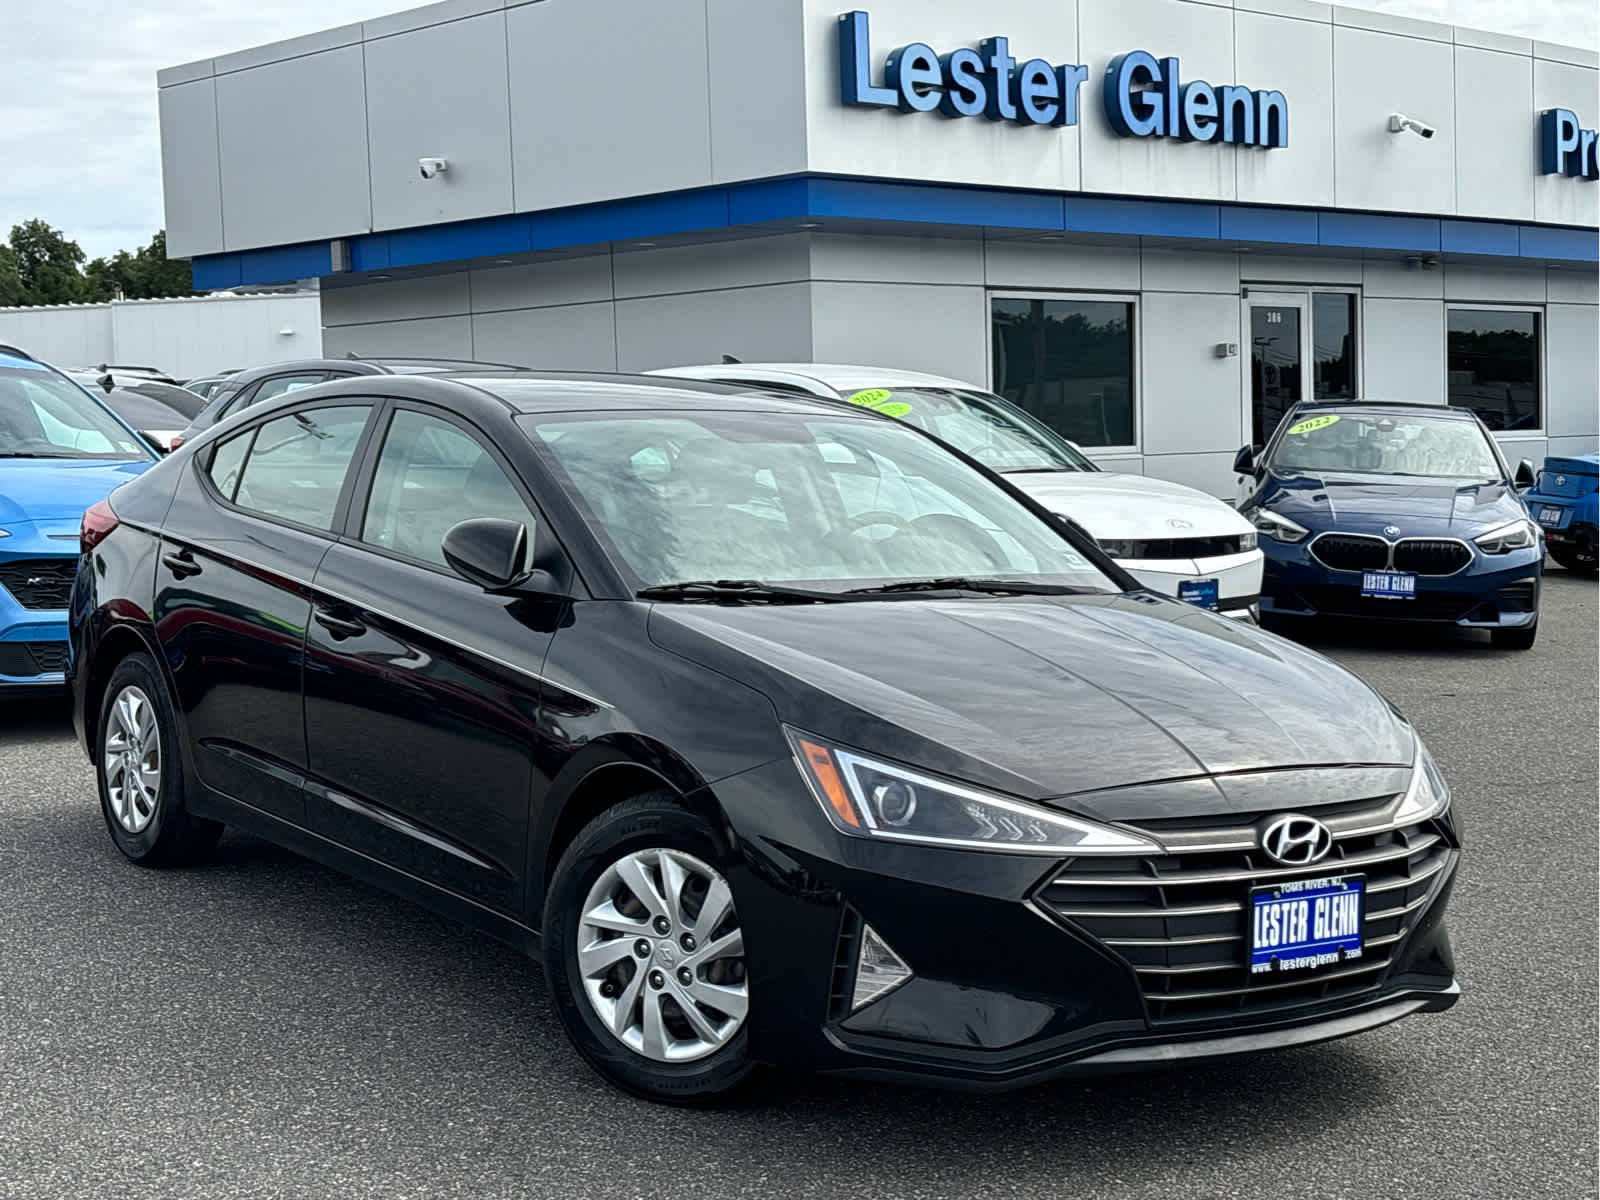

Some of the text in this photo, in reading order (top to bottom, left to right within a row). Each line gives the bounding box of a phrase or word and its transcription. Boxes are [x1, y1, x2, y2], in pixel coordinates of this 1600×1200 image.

[841, 10, 1289, 148] Lester Glenn
[1541, 108, 1599, 180] Pr
[1298, 416, 1330, 432] 2022
[1363, 574, 1415, 592] LESTER GLENN
[1280, 882, 1303, 894] TOMS
[1253, 893, 1359, 949] LESTER GLENN
[1279, 952, 1339, 970] lesterglenn
